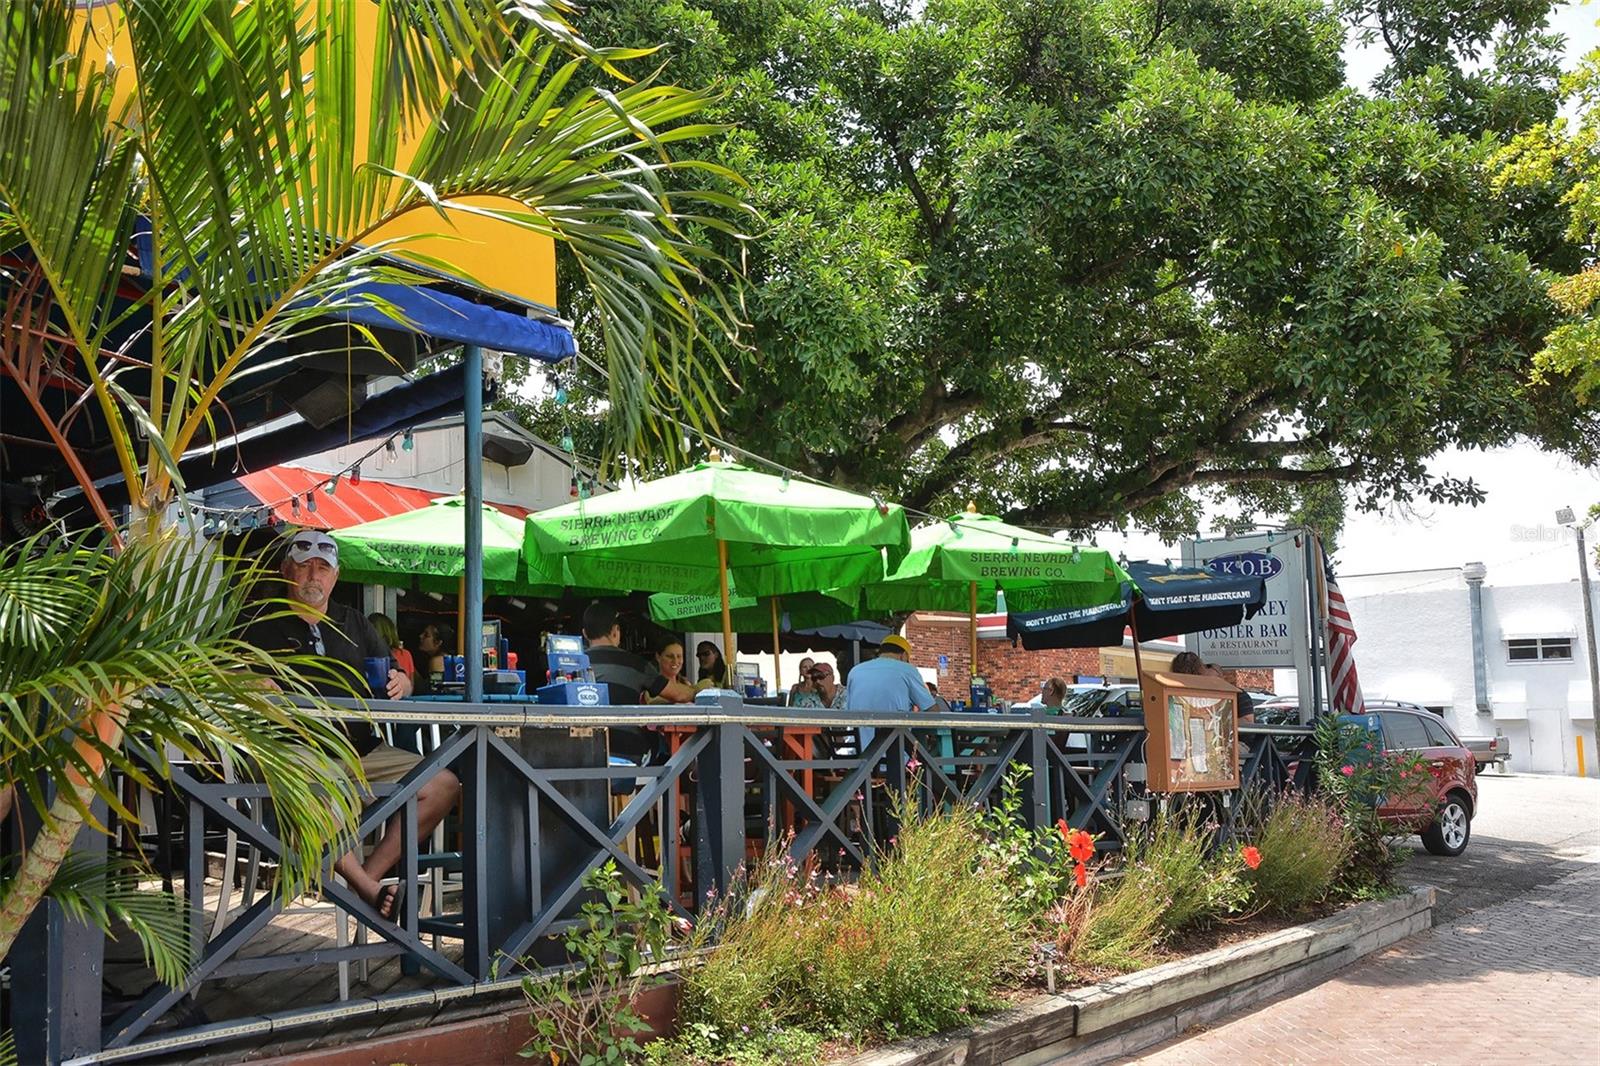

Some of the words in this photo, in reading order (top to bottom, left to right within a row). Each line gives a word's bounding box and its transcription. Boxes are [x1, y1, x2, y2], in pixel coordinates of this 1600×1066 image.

[560, 516, 612, 530] SIERRA
[617, 508, 675, 525] NEVADA
[569, 528, 638, 547] BREWING
[426, 545, 465, 556] NEVA
[970, 552, 1019, 563] SIERRA
[1023, 552, 1076, 565] NEVADA
[980, 566, 1041, 578] BREWING
[1045, 567, 1066, 578] CO.
[1166, 595, 1187, 604] FLOAT
[1189, 594, 1201, 603] THE
[677, 601, 717, 616] BREWING
[1046, 612, 1067, 624] FLOAT
[1069, 609, 1081, 620] THE
[1203, 624, 1254, 639] OYSTER
[1260, 623, 1288, 637] BAR
[1210, 641, 1217, 649] &
[1220, 639, 1279, 649] RESTAURANT
